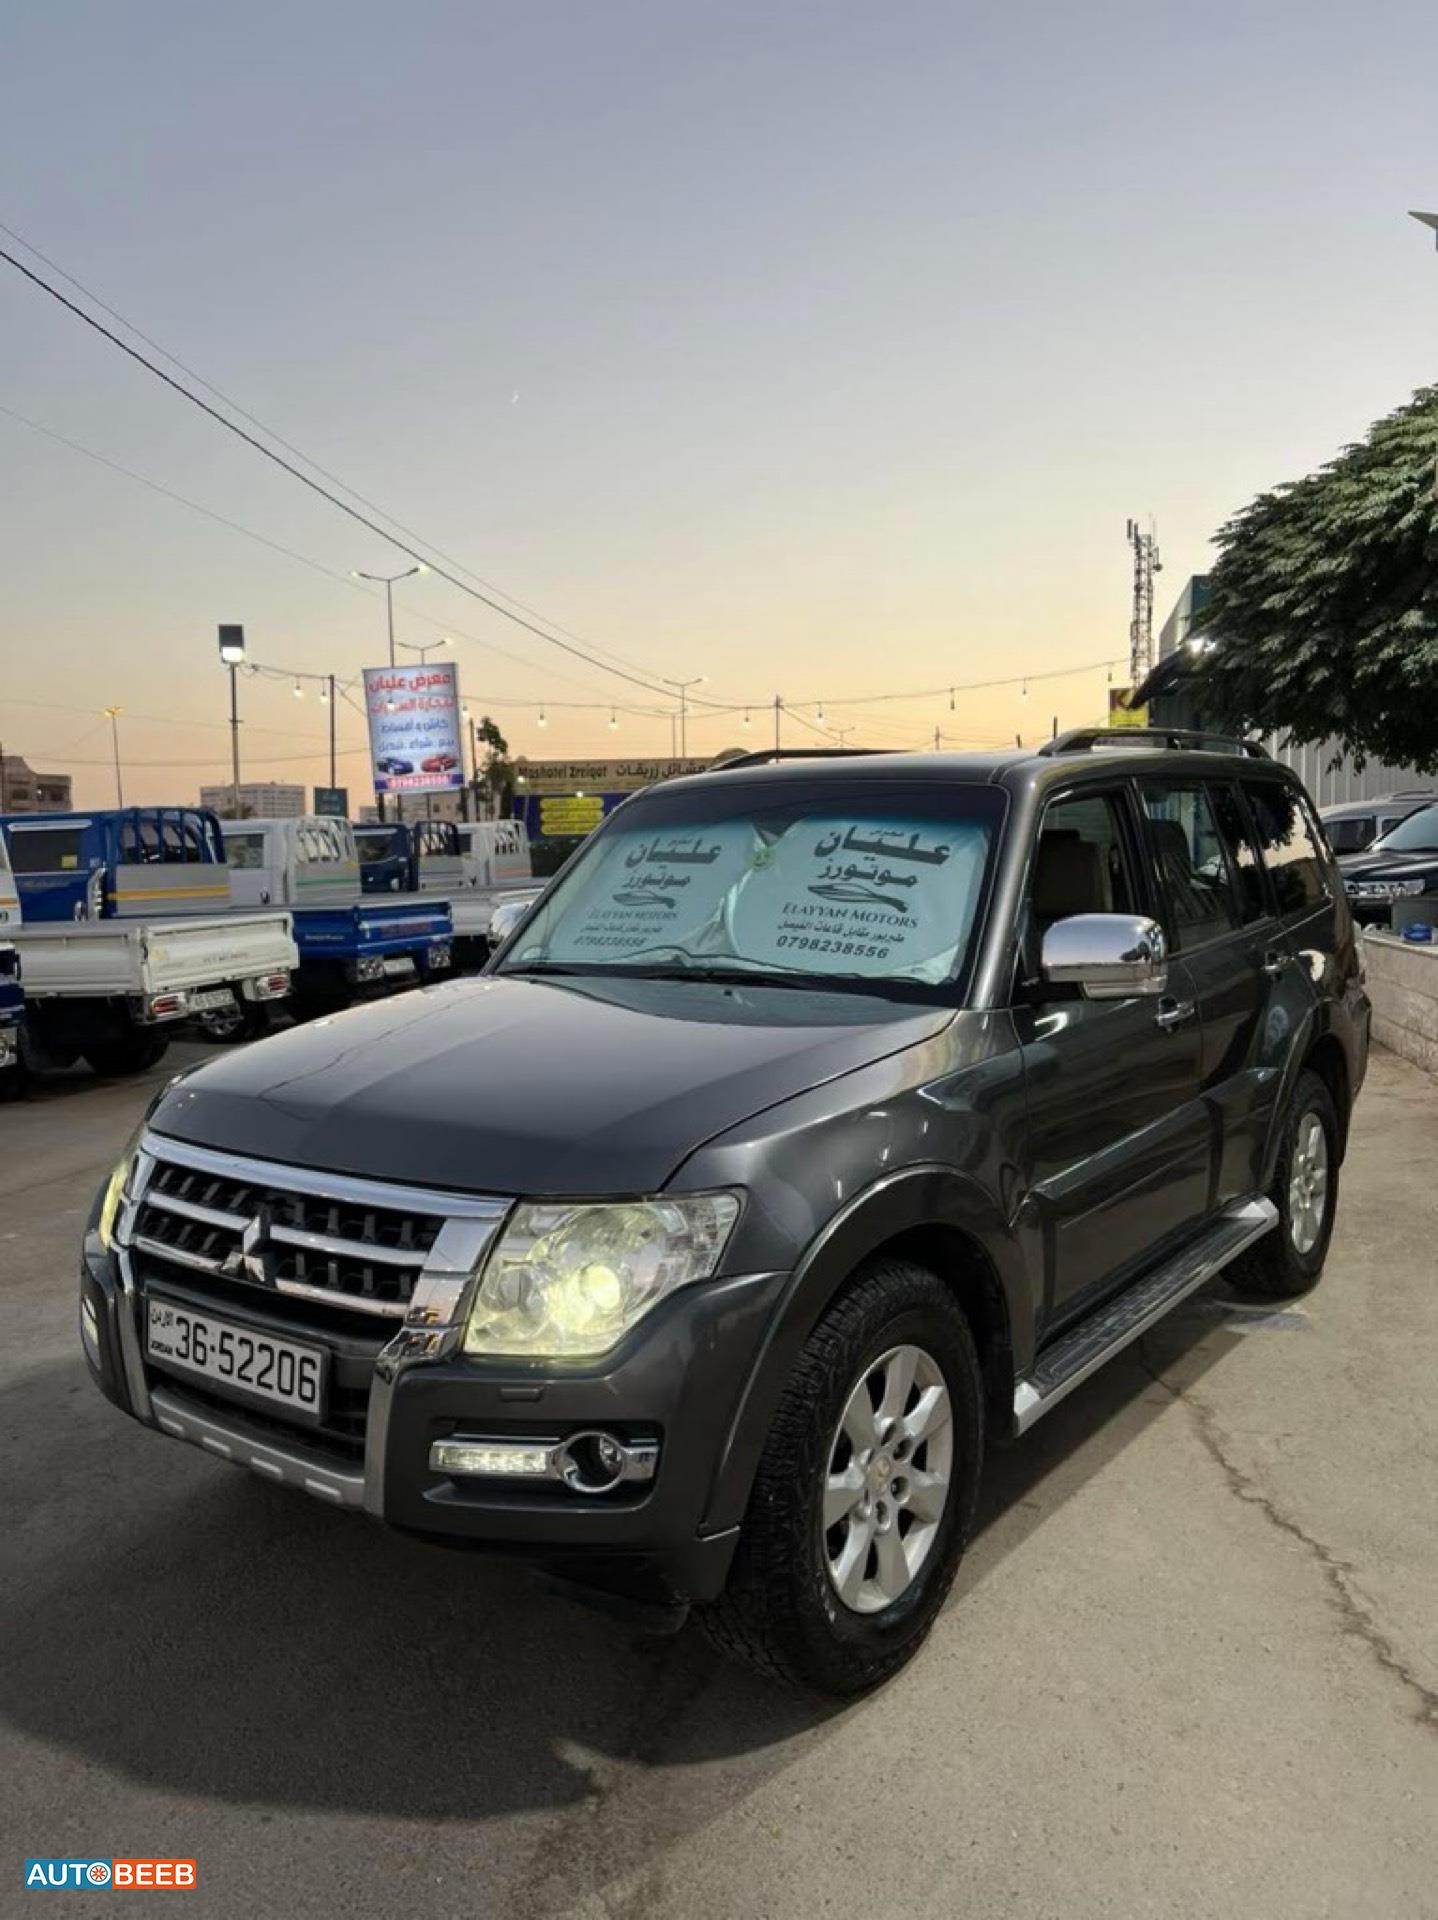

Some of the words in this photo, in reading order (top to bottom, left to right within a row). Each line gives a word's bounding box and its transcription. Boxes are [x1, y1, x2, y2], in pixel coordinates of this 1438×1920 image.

[368, 676, 406, 693] عليان
[409, 674, 450, 693] معرض
[616, 766, 659, 779] زريقات
[814, 825, 950, 866] عليان
[817, 858, 919, 888] موتورز
[782, 901, 848, 918] ELAYYAN
[850, 908, 919, 929] MOTORS
[776, 935, 890, 959] 0798238556
[175, 1316, 318, 1404] 36-52206
